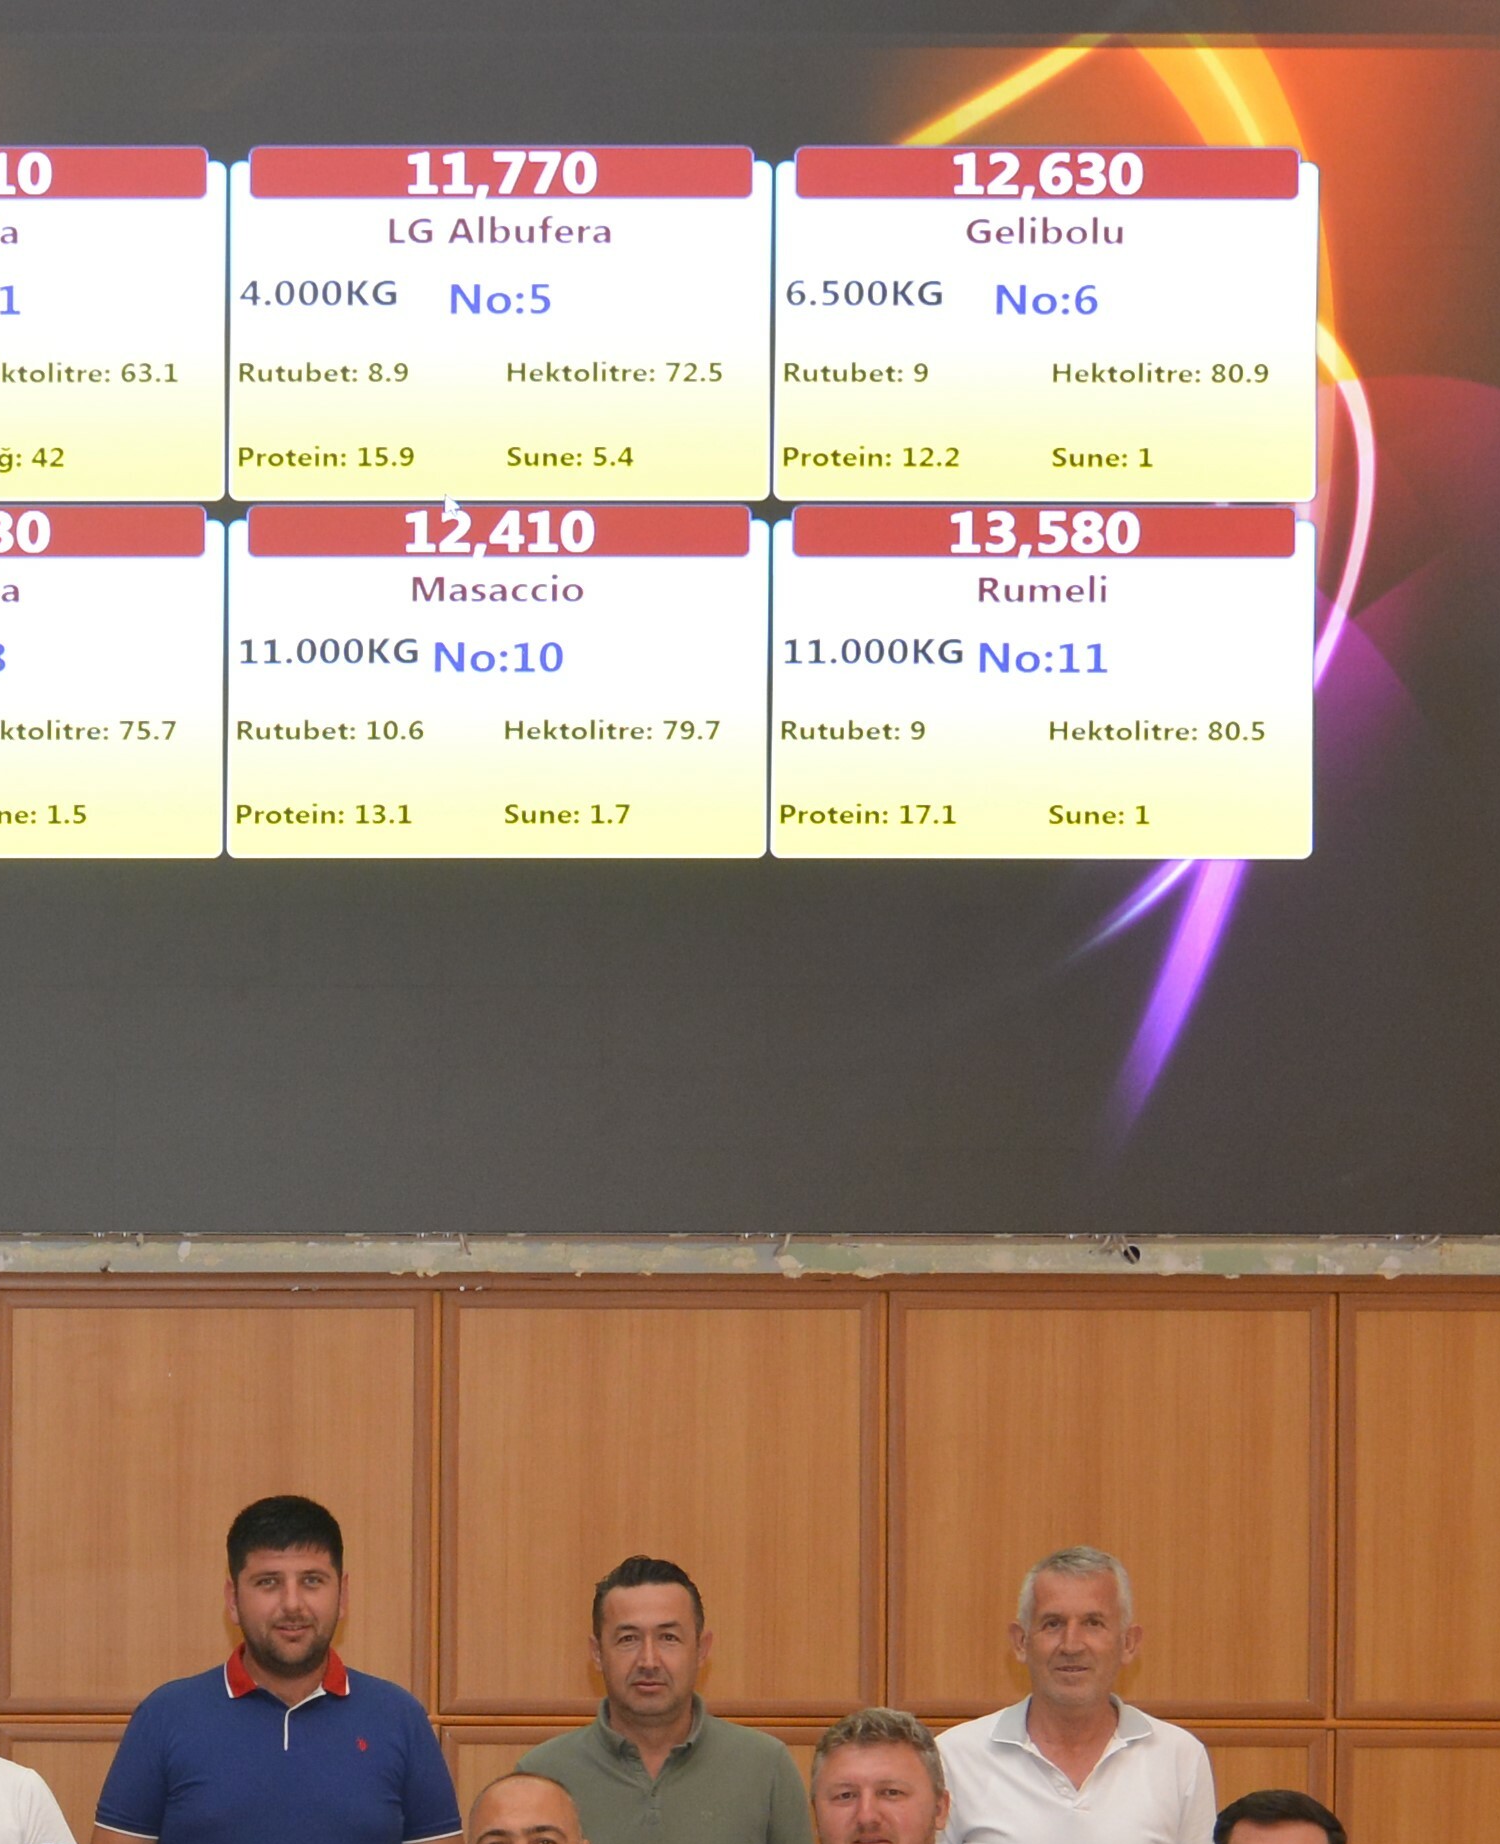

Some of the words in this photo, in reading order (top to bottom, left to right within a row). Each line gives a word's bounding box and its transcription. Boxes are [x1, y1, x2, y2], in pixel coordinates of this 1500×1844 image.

[407, 150, 598, 200] 11,770
[953, 151, 1144, 200] 12,630
[388, 217, 433, 244] LG
[447, 215, 612, 244] Albufera
[965, 216, 1124, 245] Gelibolu
[239, 279, 397, 307] 4.000KG
[450, 283, 551, 315] No:5
[785, 279, 943, 307] 6.500KG
[995, 284, 1099, 316] No:6
[120, 362, 179, 383] 63.1
[238, 361, 358, 383] Rutubet:
[368, 362, 409, 383] 8.9
[507, 361, 655, 383] Hektolitre:
[665, 362, 723, 383] 72.5
[31, 447, 64, 468] 42
[238, 445, 347, 468] Protein:
[358, 446, 415, 467] 15.9
[507, 446, 583, 467] Sune:
[593, 446, 634, 467] 5.4
[405, 508, 595, 558] 12,410
[950, 510, 1141, 558] 13,580
[411, 574, 584, 603] Masaccio
[978, 574, 1107, 604] Rumeli
[240, 637, 419, 665] 11.000KG
[434, 641, 564, 673] No:10
[784, 638, 964, 665] 11.000KG
[979, 642, 1108, 674] No:11
